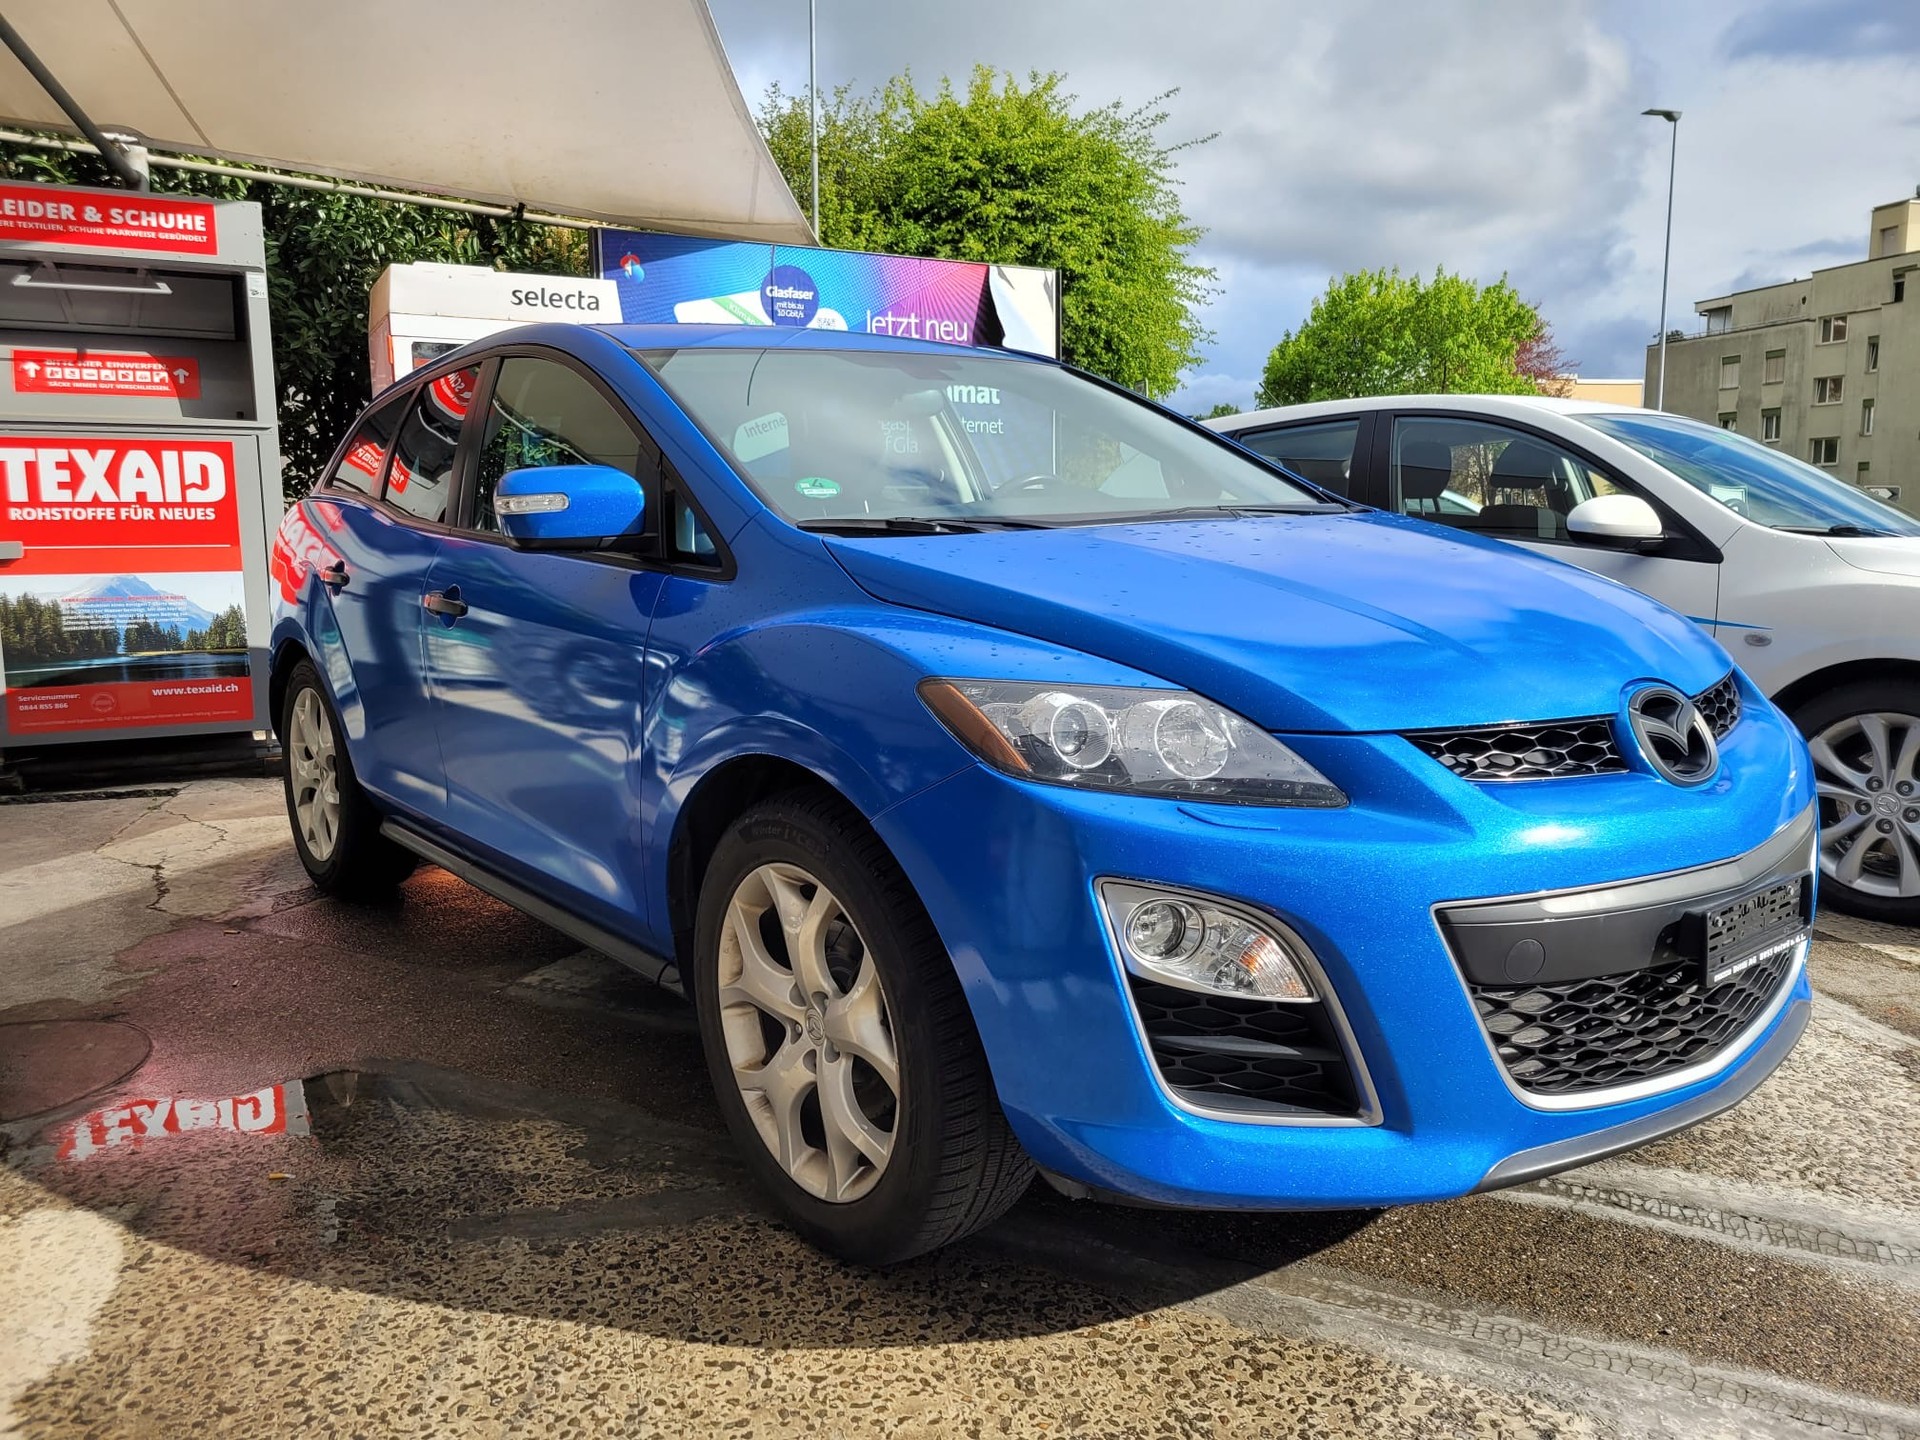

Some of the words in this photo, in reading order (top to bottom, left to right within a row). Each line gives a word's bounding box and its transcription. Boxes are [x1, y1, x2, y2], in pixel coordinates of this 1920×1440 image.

[0, 198, 76, 221] EIDER
[83, 205, 103, 223] &
[109, 207, 206, 231] SCHUHE
[16, 221, 67, 232] TEXTILIEN,
[68, 225, 104, 235] SCHUHE
[106, 228, 157, 239] PAARWEISE
[158, 231, 208, 243] GEBÜNDELT
[510, 287, 600, 311] selecta
[765, 285, 814, 301] Glasfaser
[776, 301, 787, 309] mit
[788, 301, 796, 309] bis
[776, 309, 786, 317] 10
[925, 317, 968, 342] neu
[0, 447, 226, 503] TEXAID
[9, 507, 116, 521] ROHSTOFFE
[120, 504, 155, 521] FÜR
[159, 507, 216, 521] NEUES
[152, 683, 239, 697] www.texaid.ch
